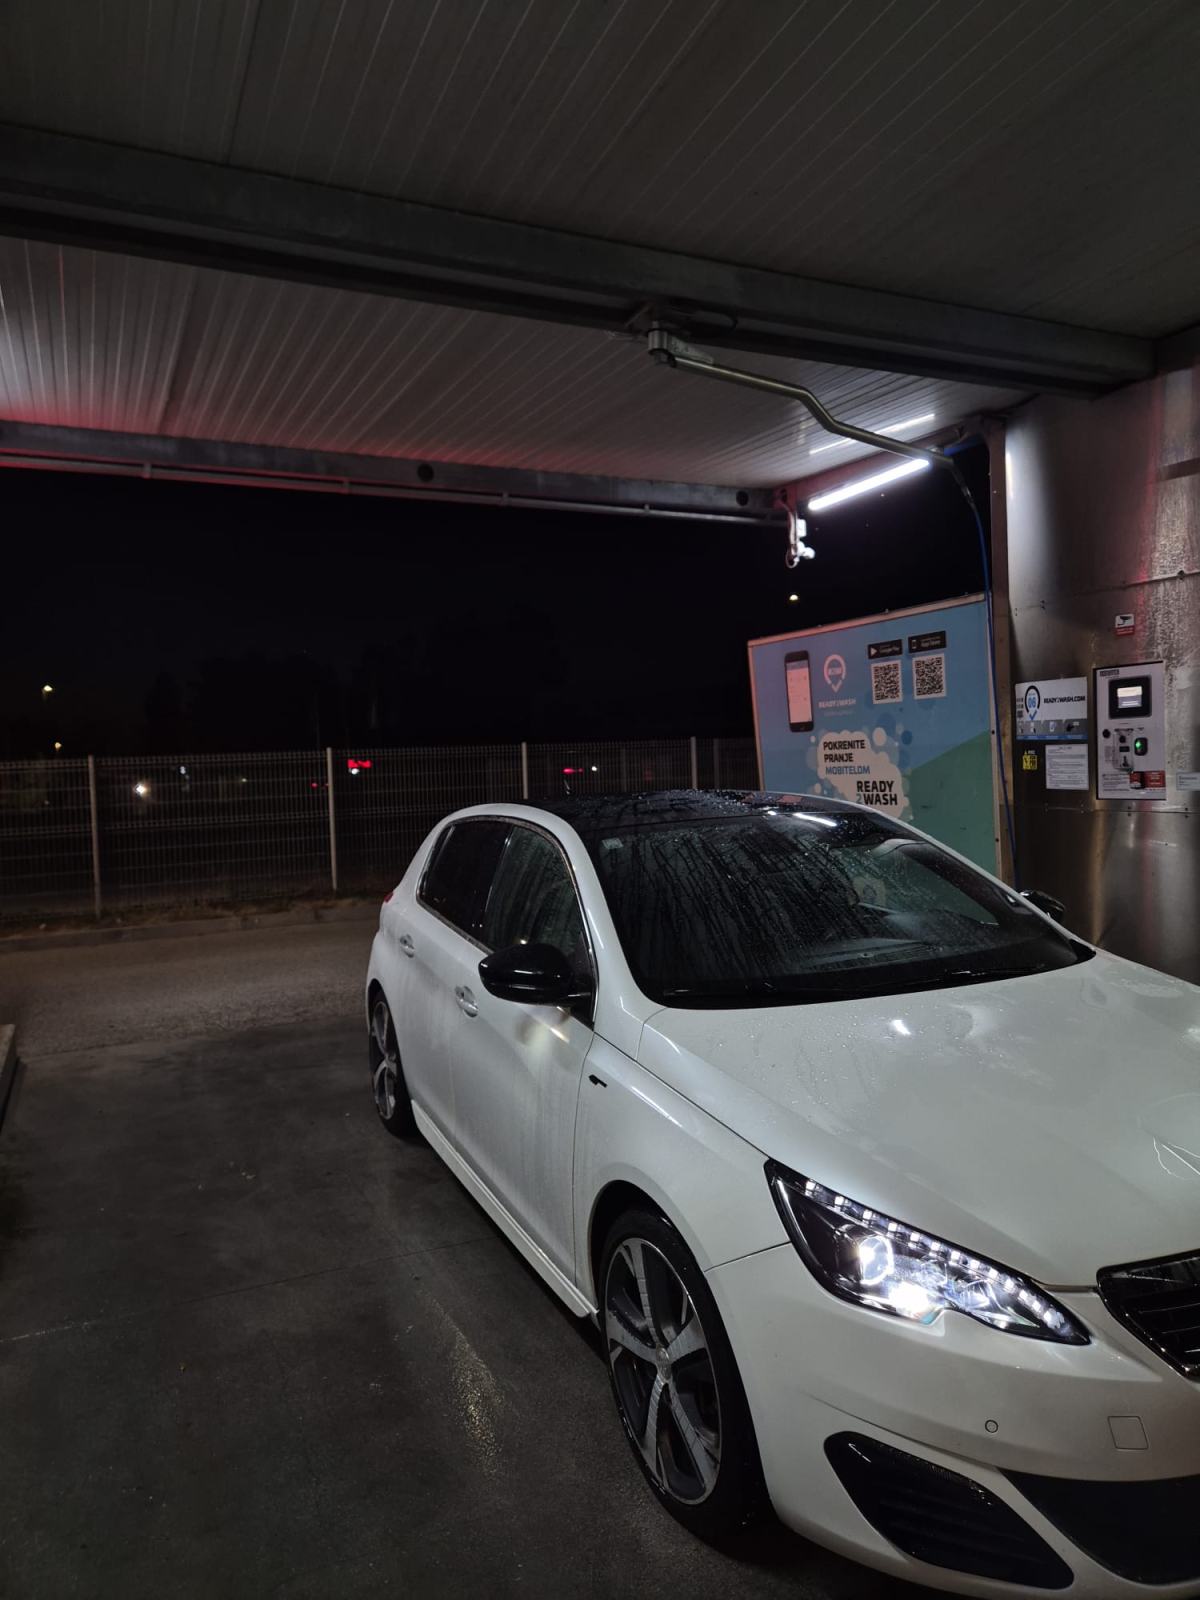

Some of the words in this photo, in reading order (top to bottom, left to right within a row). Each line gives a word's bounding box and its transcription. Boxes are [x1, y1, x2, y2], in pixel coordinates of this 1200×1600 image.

[823, 740, 865, 750] POKRENITE
[824, 753, 853, 763] PRANJE
[825, 766, 870, 775] MOBITELOM
[856, 780, 894, 793] READY
